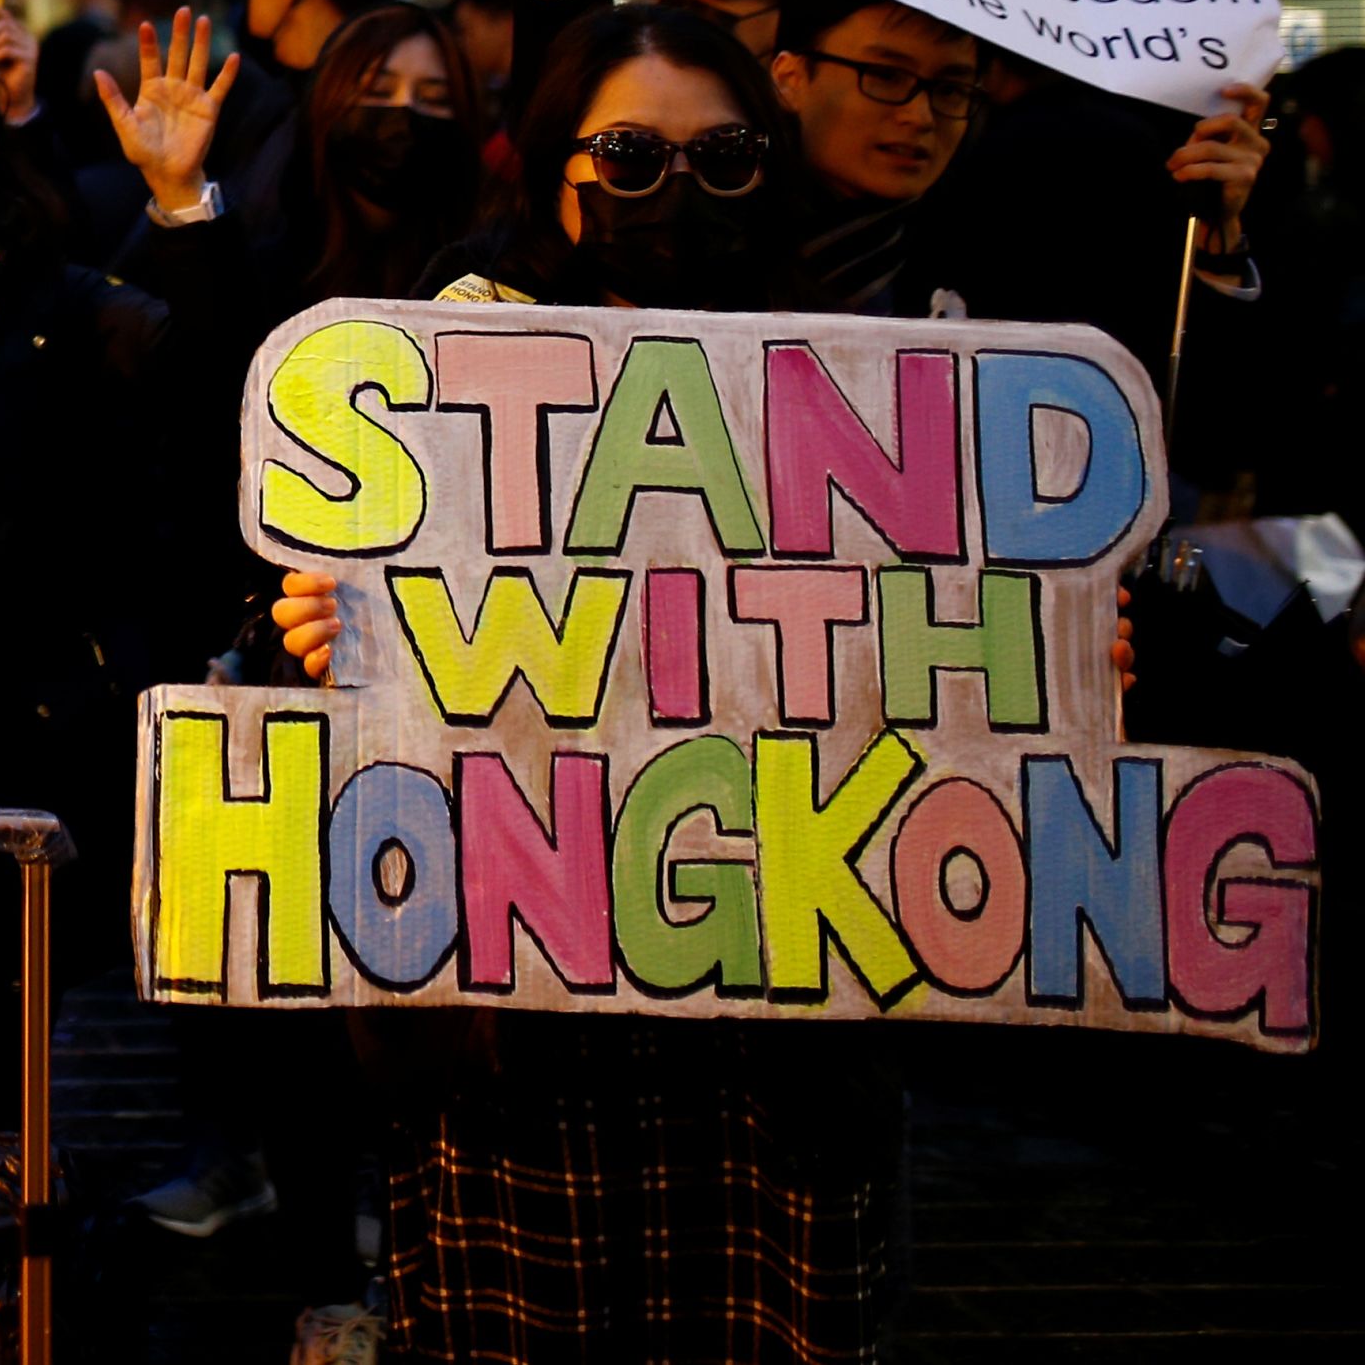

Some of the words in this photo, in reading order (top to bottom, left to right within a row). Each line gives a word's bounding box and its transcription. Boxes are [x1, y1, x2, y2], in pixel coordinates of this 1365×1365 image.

[1022, 8, 1230, 70] world's
[458, 280, 492, 298] STAND
[260, 320, 1146, 569] STAND
[385, 565, 1050, 733] WITH
[152, 709, 1321, 1034] HONGKONG
